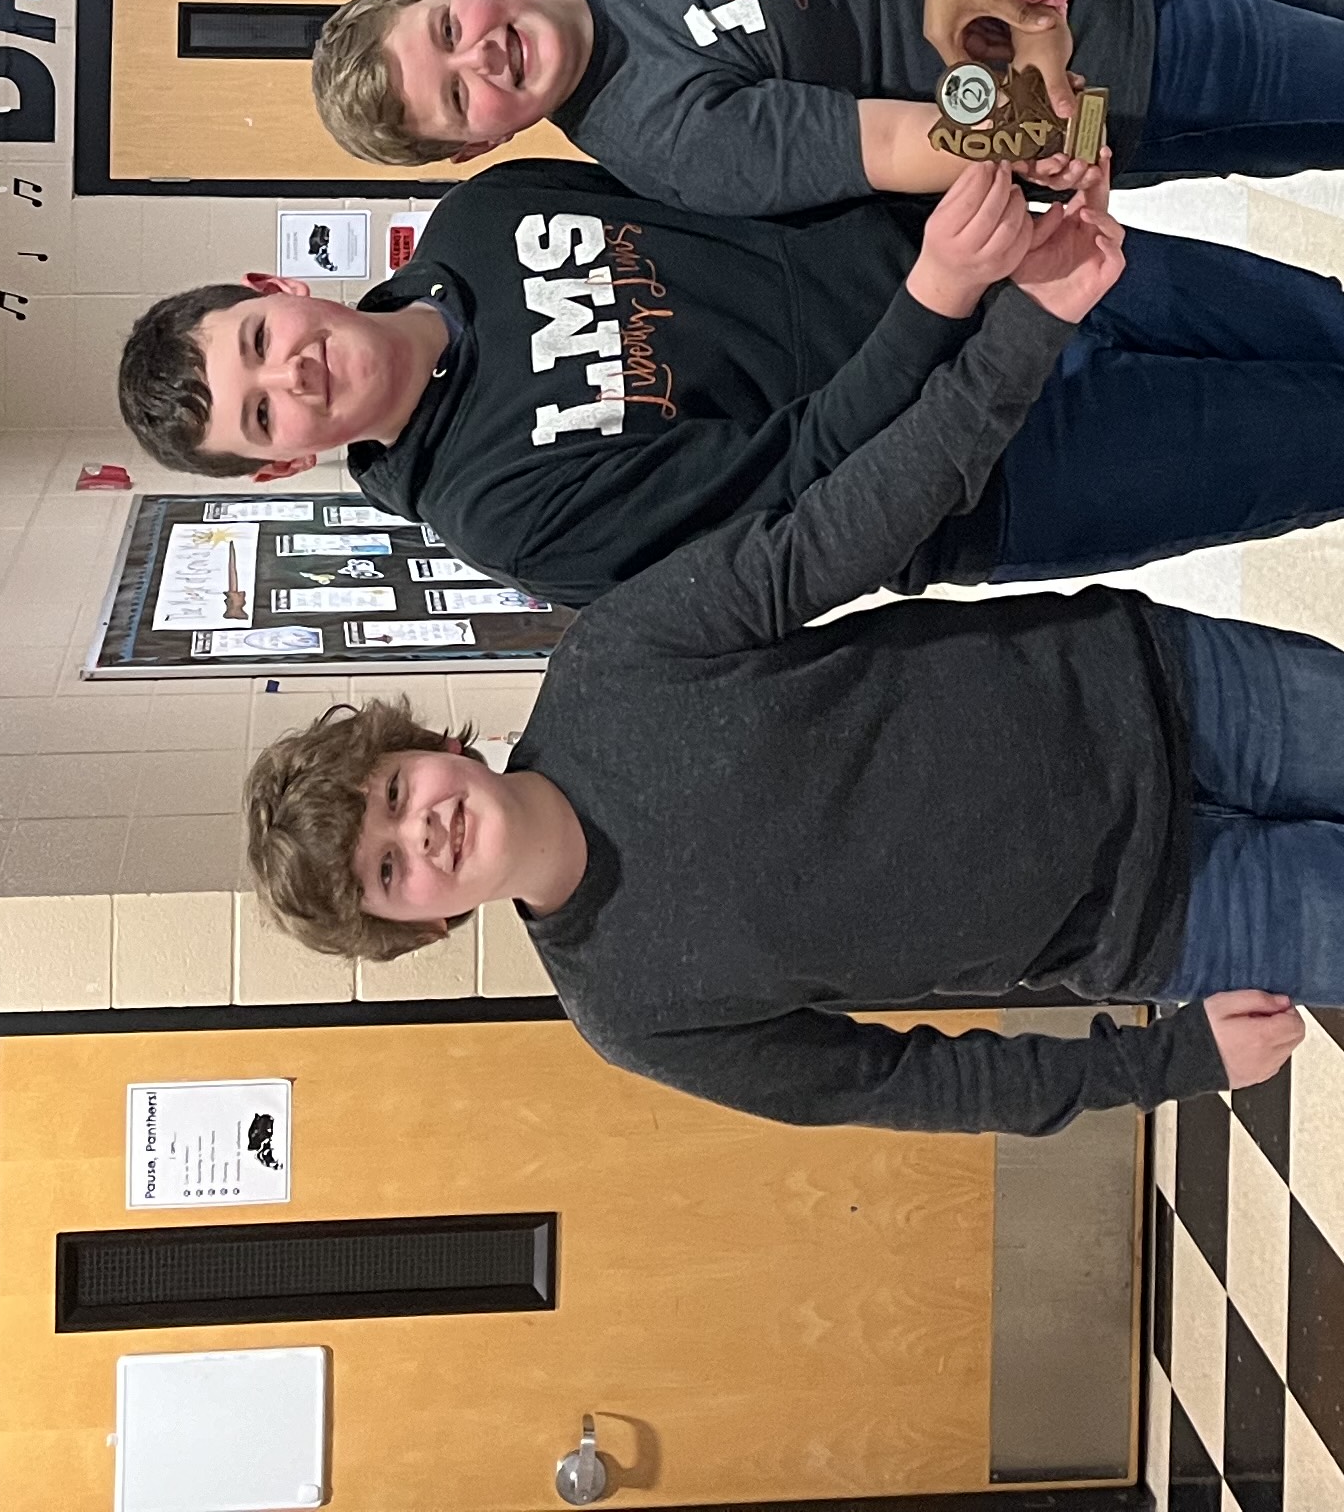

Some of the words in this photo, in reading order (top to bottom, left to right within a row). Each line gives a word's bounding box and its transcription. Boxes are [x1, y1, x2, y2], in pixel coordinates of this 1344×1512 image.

[962, 87, 982, 102] 2
[931, 119, 1053, 159] 2024
[514, 213, 625, 446] LMS
[595, 297, 677, 419] Liberty
[145, 1091, 158, 1152] Panthers!
[144, 1157, 159, 1199] Pause,
